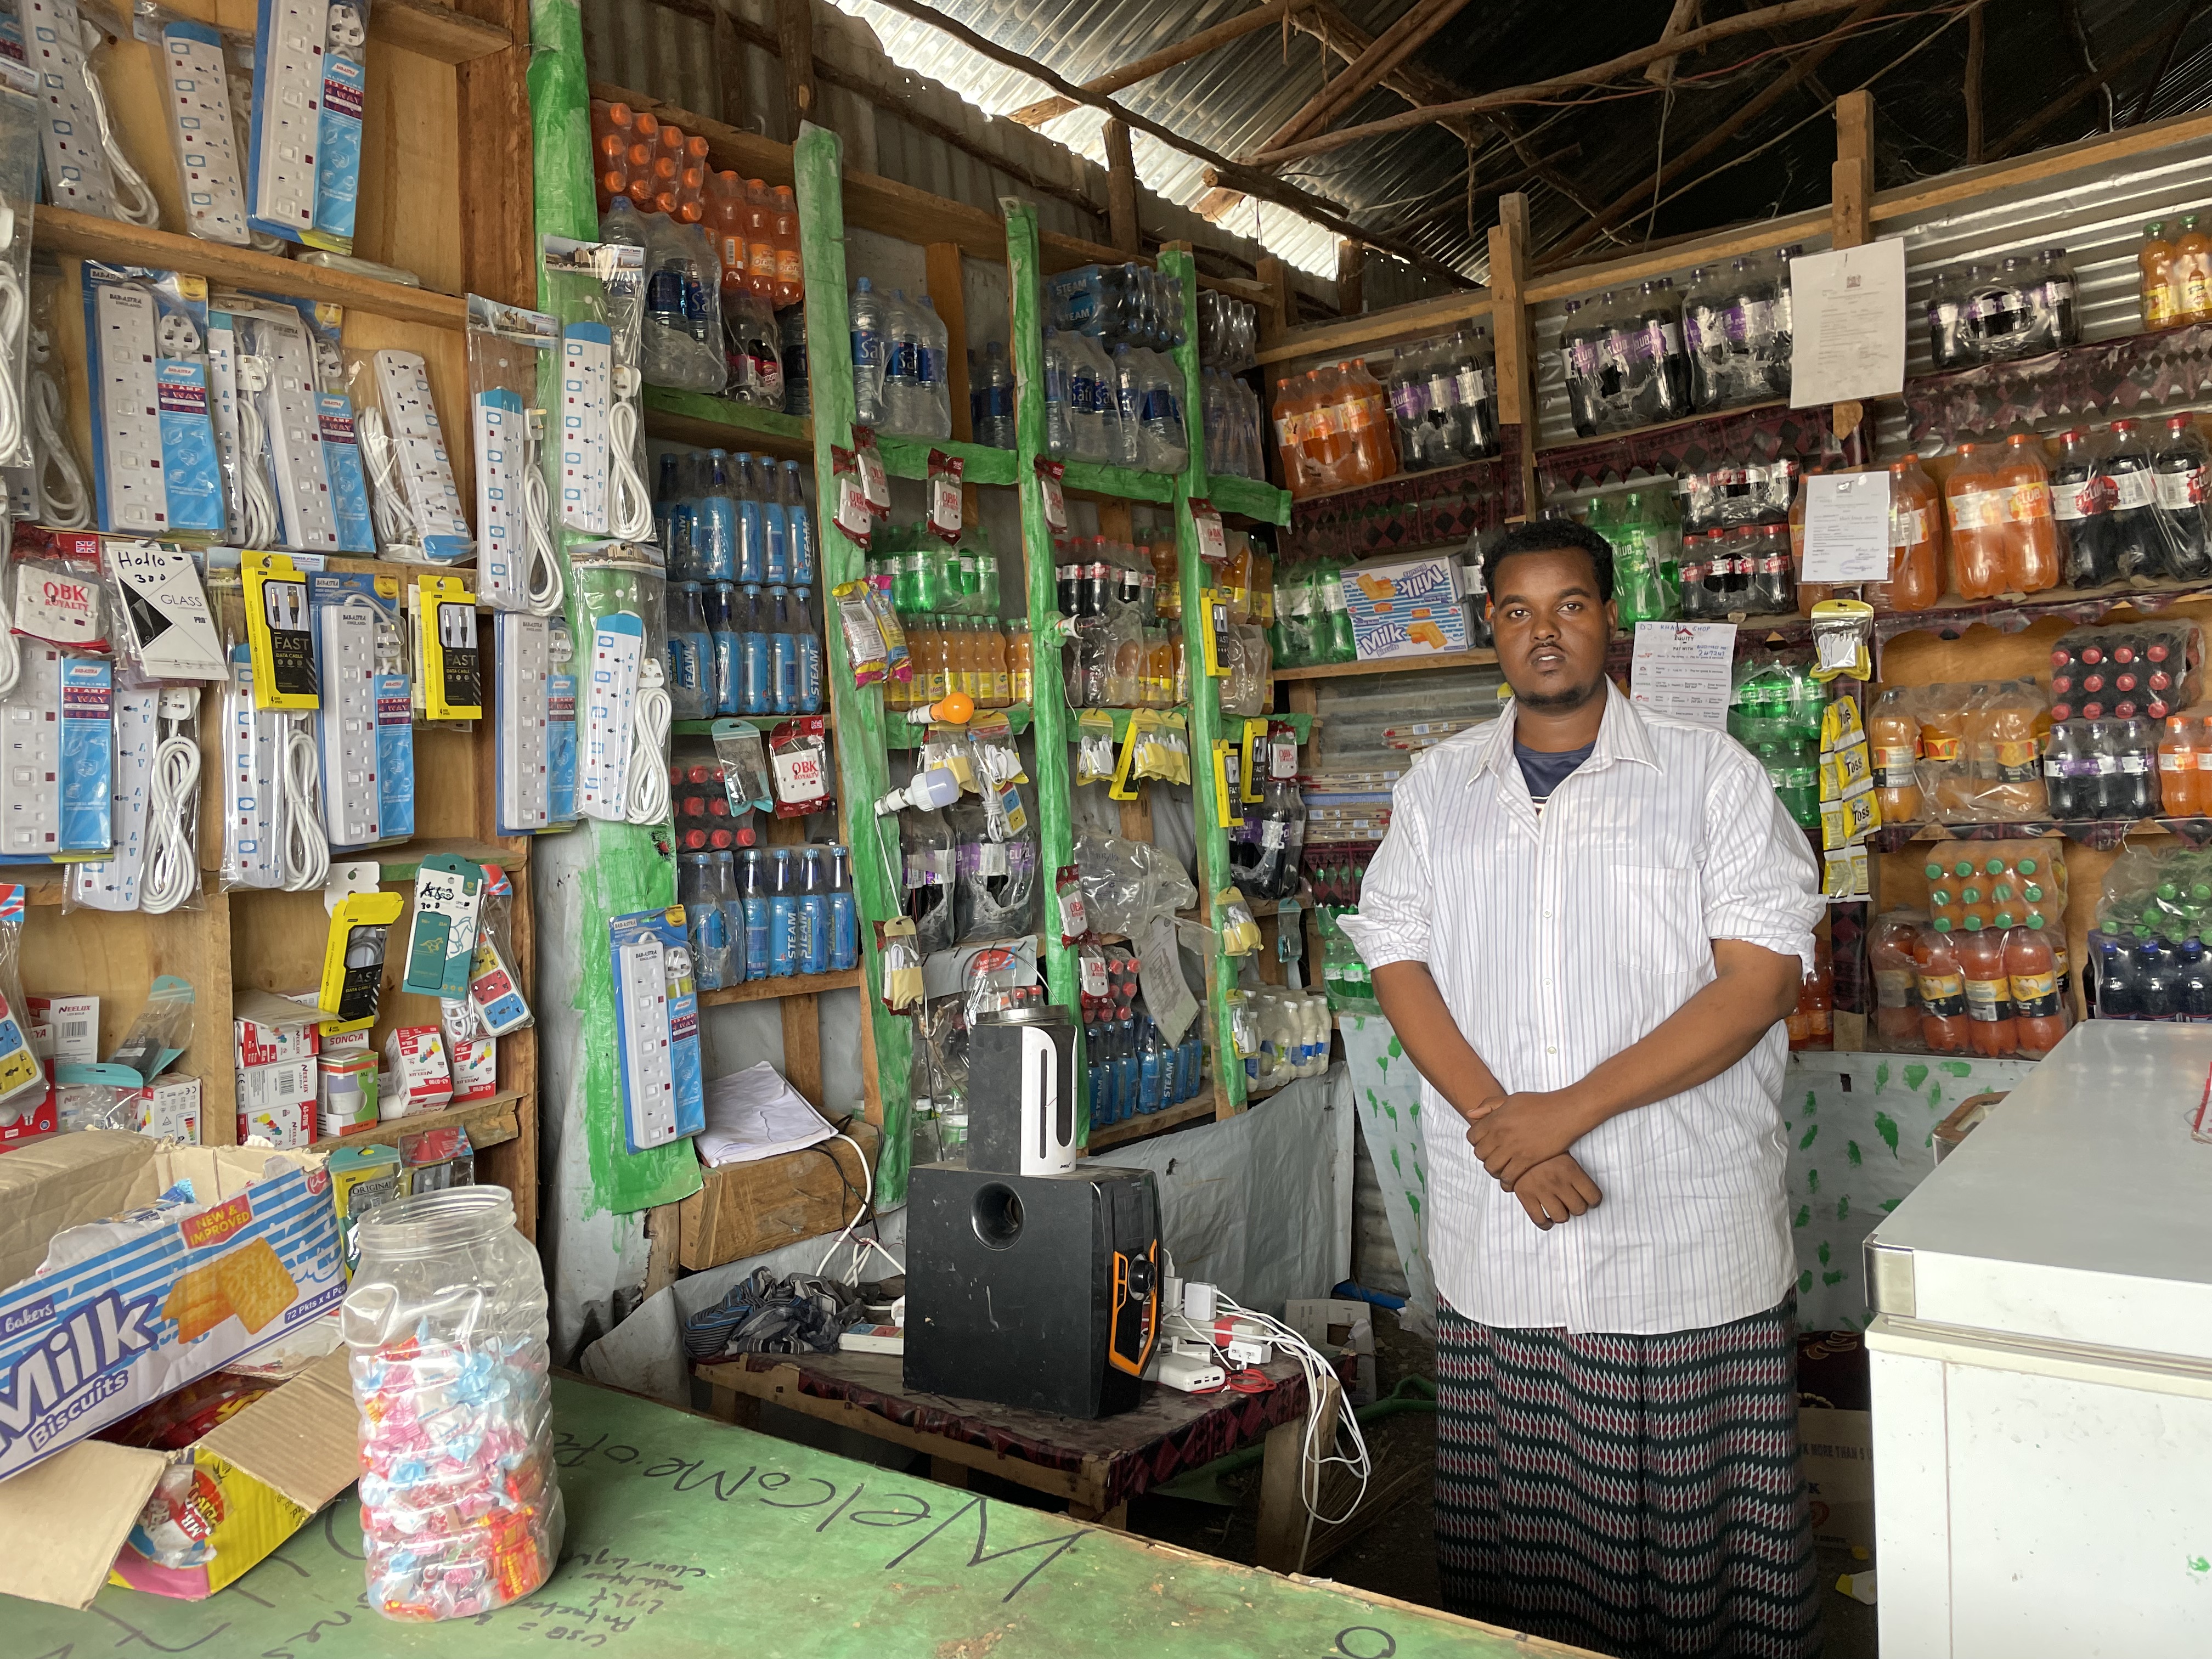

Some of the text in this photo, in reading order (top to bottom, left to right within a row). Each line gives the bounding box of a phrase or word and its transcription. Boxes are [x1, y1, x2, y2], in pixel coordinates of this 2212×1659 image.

[109, 293, 142, 304] BAB-ASTRA
[173, 391, 203, 400] WAY
[2015, 487, 2041, 506] CLUB
[1399, 566, 1444, 598] Milk
[43, 582, 88, 603] OBK
[44, 598, 89, 611] ROYALTY
[161, 594, 202, 607] GLASS
[275, 636, 309, 651] FAST
[1359, 623, 1406, 655] Milk
[1377, 645, 1400, 657] Biscuits
[445, 654, 476, 666] FAST
[810, 649, 821, 696] STEAM
[77, 695, 108, 703] WAY
[792, 760, 818, 774] OBK
[793, 772, 820, 781] ROYALTY
[1229, 786, 1240, 794] FAST
[614, 920, 636, 929] BAB-ASTRA
[787, 912, 798, 959] STEAM
[635, 950, 657, 959] BAB-ASTRA
[59, 1005, 92, 1014] NEELUX
[329, 1032, 364, 1046] SONGYA
[1164, 1061, 1175, 1099] STEAM
[352, 1181, 394, 1195] ORIGINAL
[195, 1204, 239, 1229] NEW &
[189, 1211, 251, 1245] IMPROVED
[286, 1284, 346, 1319] 72 Pkts x 4 Pcs
[0, 1295, 151, 1452] Milk
[30, 1370, 128, 1451] Biscuits
[181, 1511, 204, 1542] MR.
